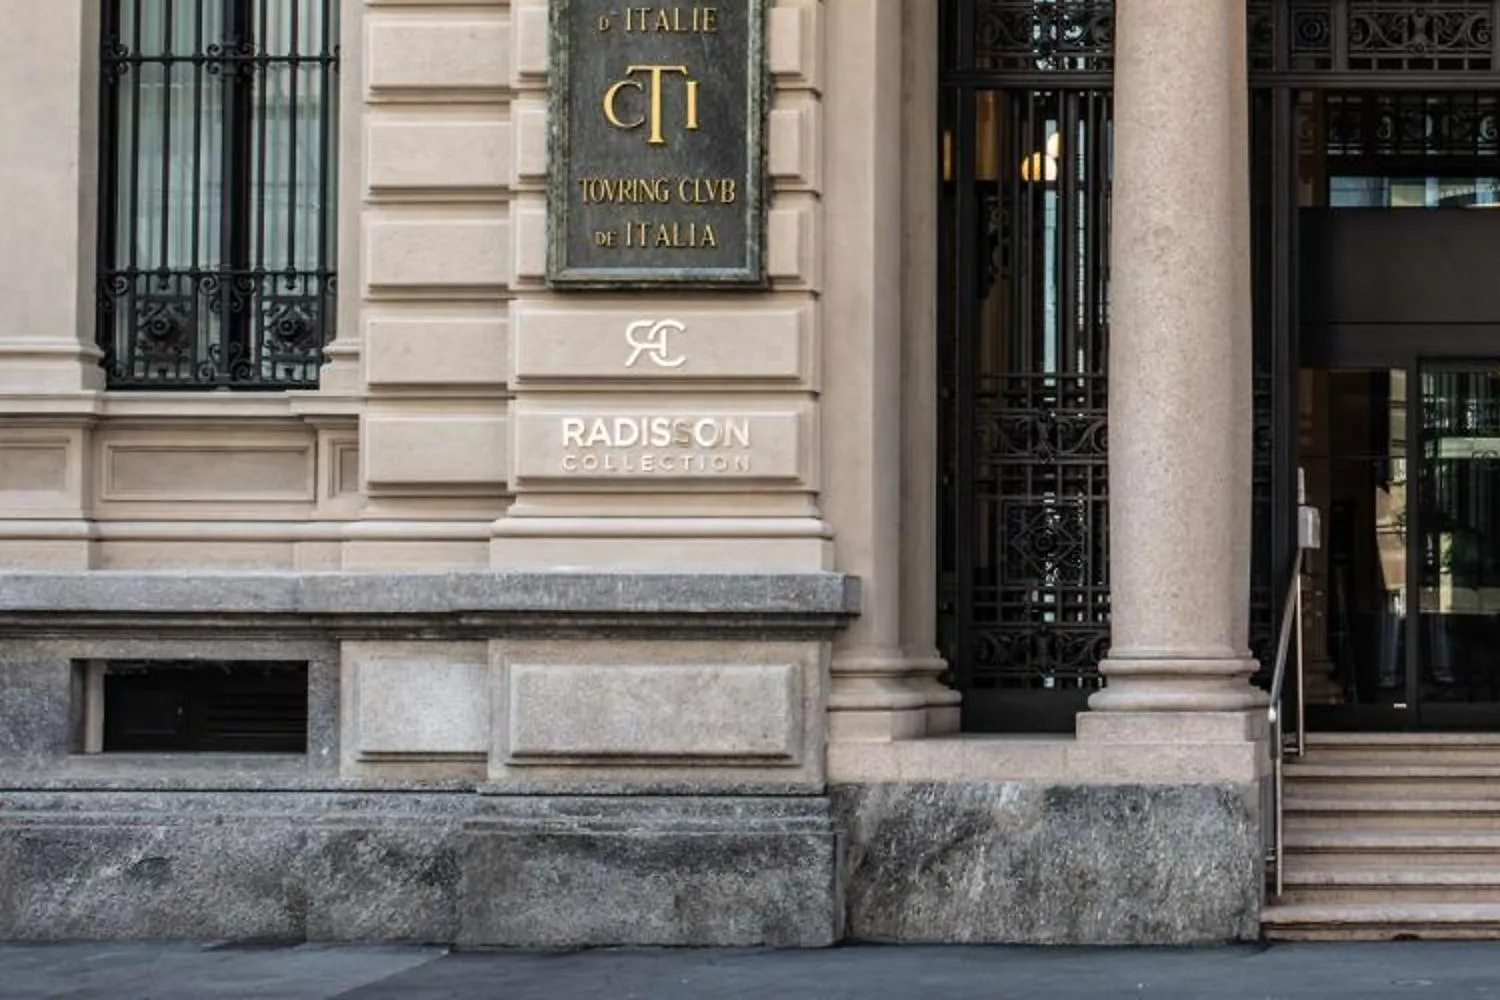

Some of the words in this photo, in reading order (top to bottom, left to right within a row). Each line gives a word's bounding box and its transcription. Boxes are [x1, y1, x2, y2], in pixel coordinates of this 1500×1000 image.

[625, 6, 718, 33] ITALIE
[625, 220, 718, 248] ITALIA
[561, 417, 751, 448] RADISSON
[561, 454, 751, 472] COLLECTION
